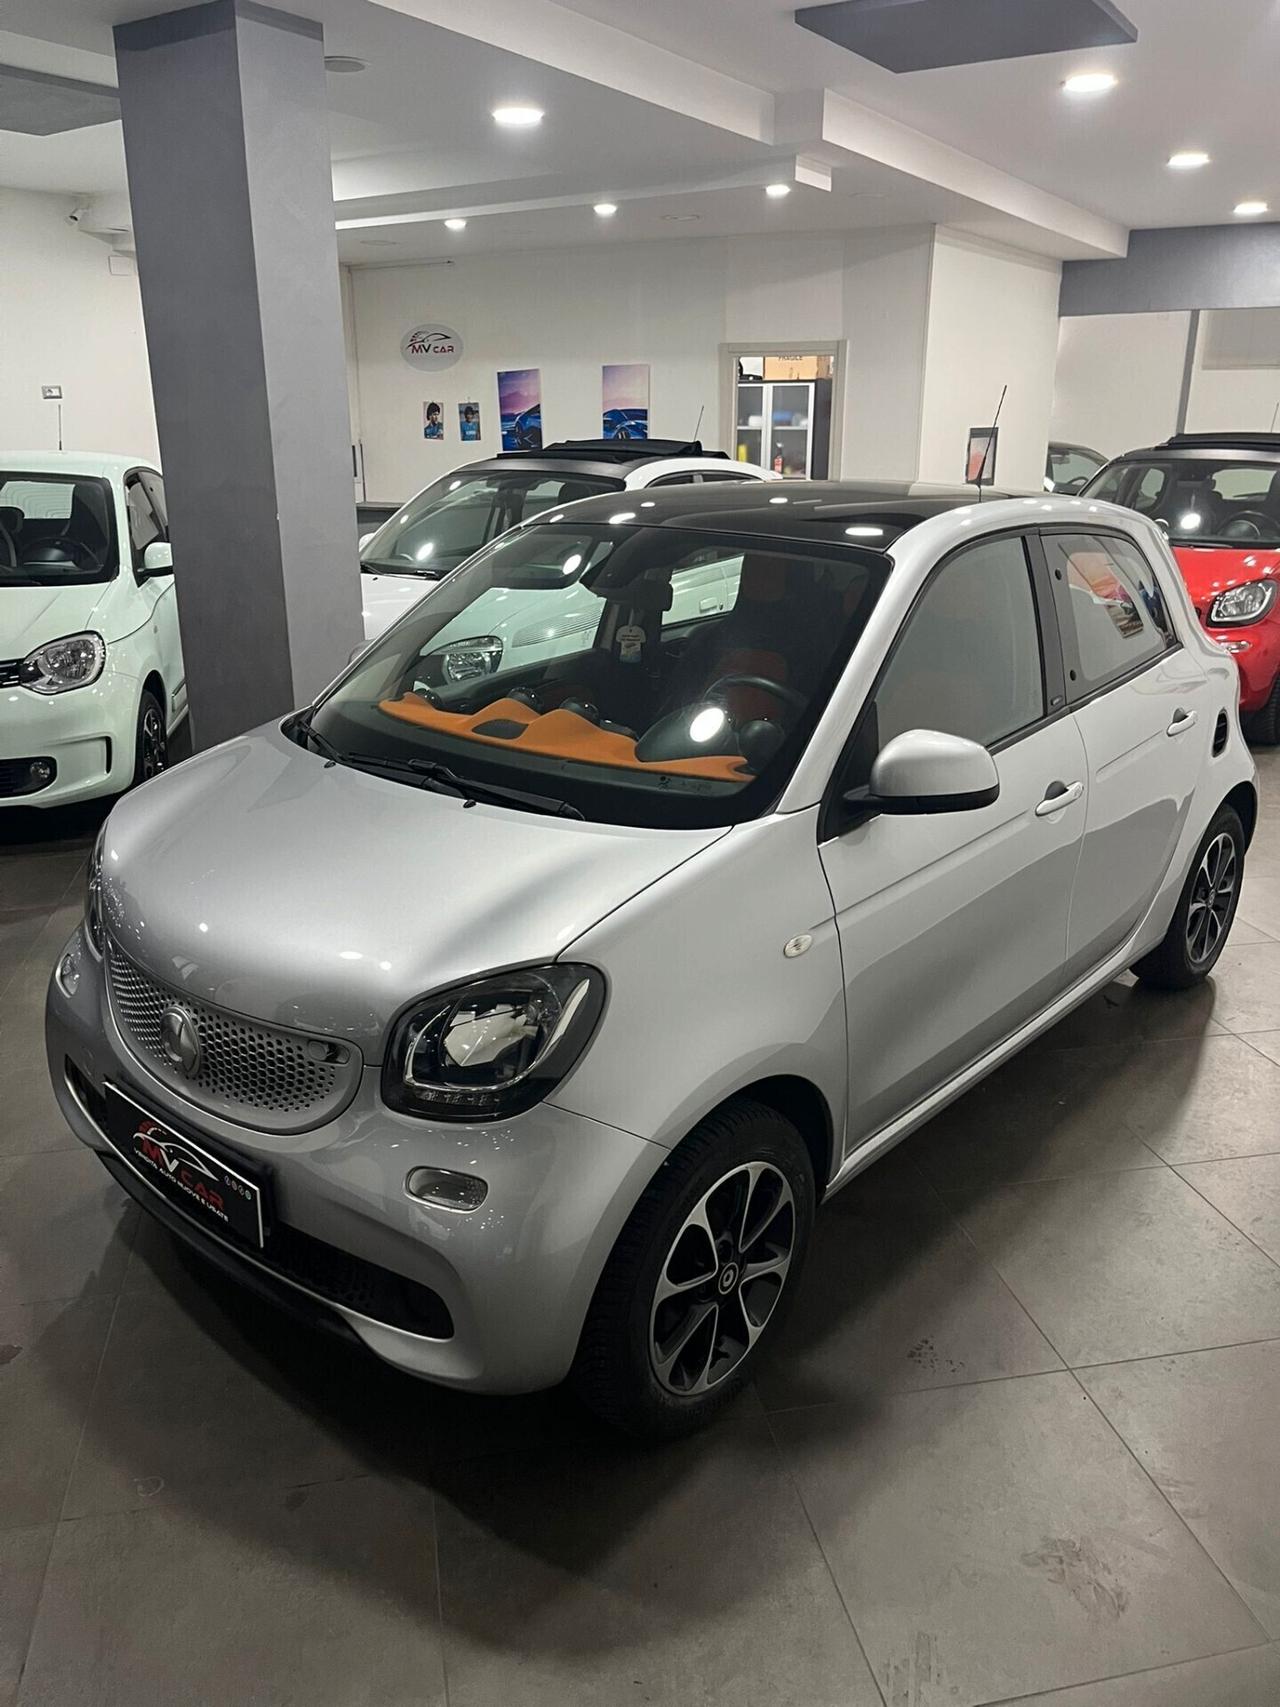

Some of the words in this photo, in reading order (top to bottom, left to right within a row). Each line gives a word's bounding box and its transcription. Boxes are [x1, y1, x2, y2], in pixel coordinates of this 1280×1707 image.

[411, 344, 431, 354] MV
[433, 345, 454, 354] CAR
[159, 1168, 177, 1184] AUTO
[206, 1201, 229, 1223] USATE
